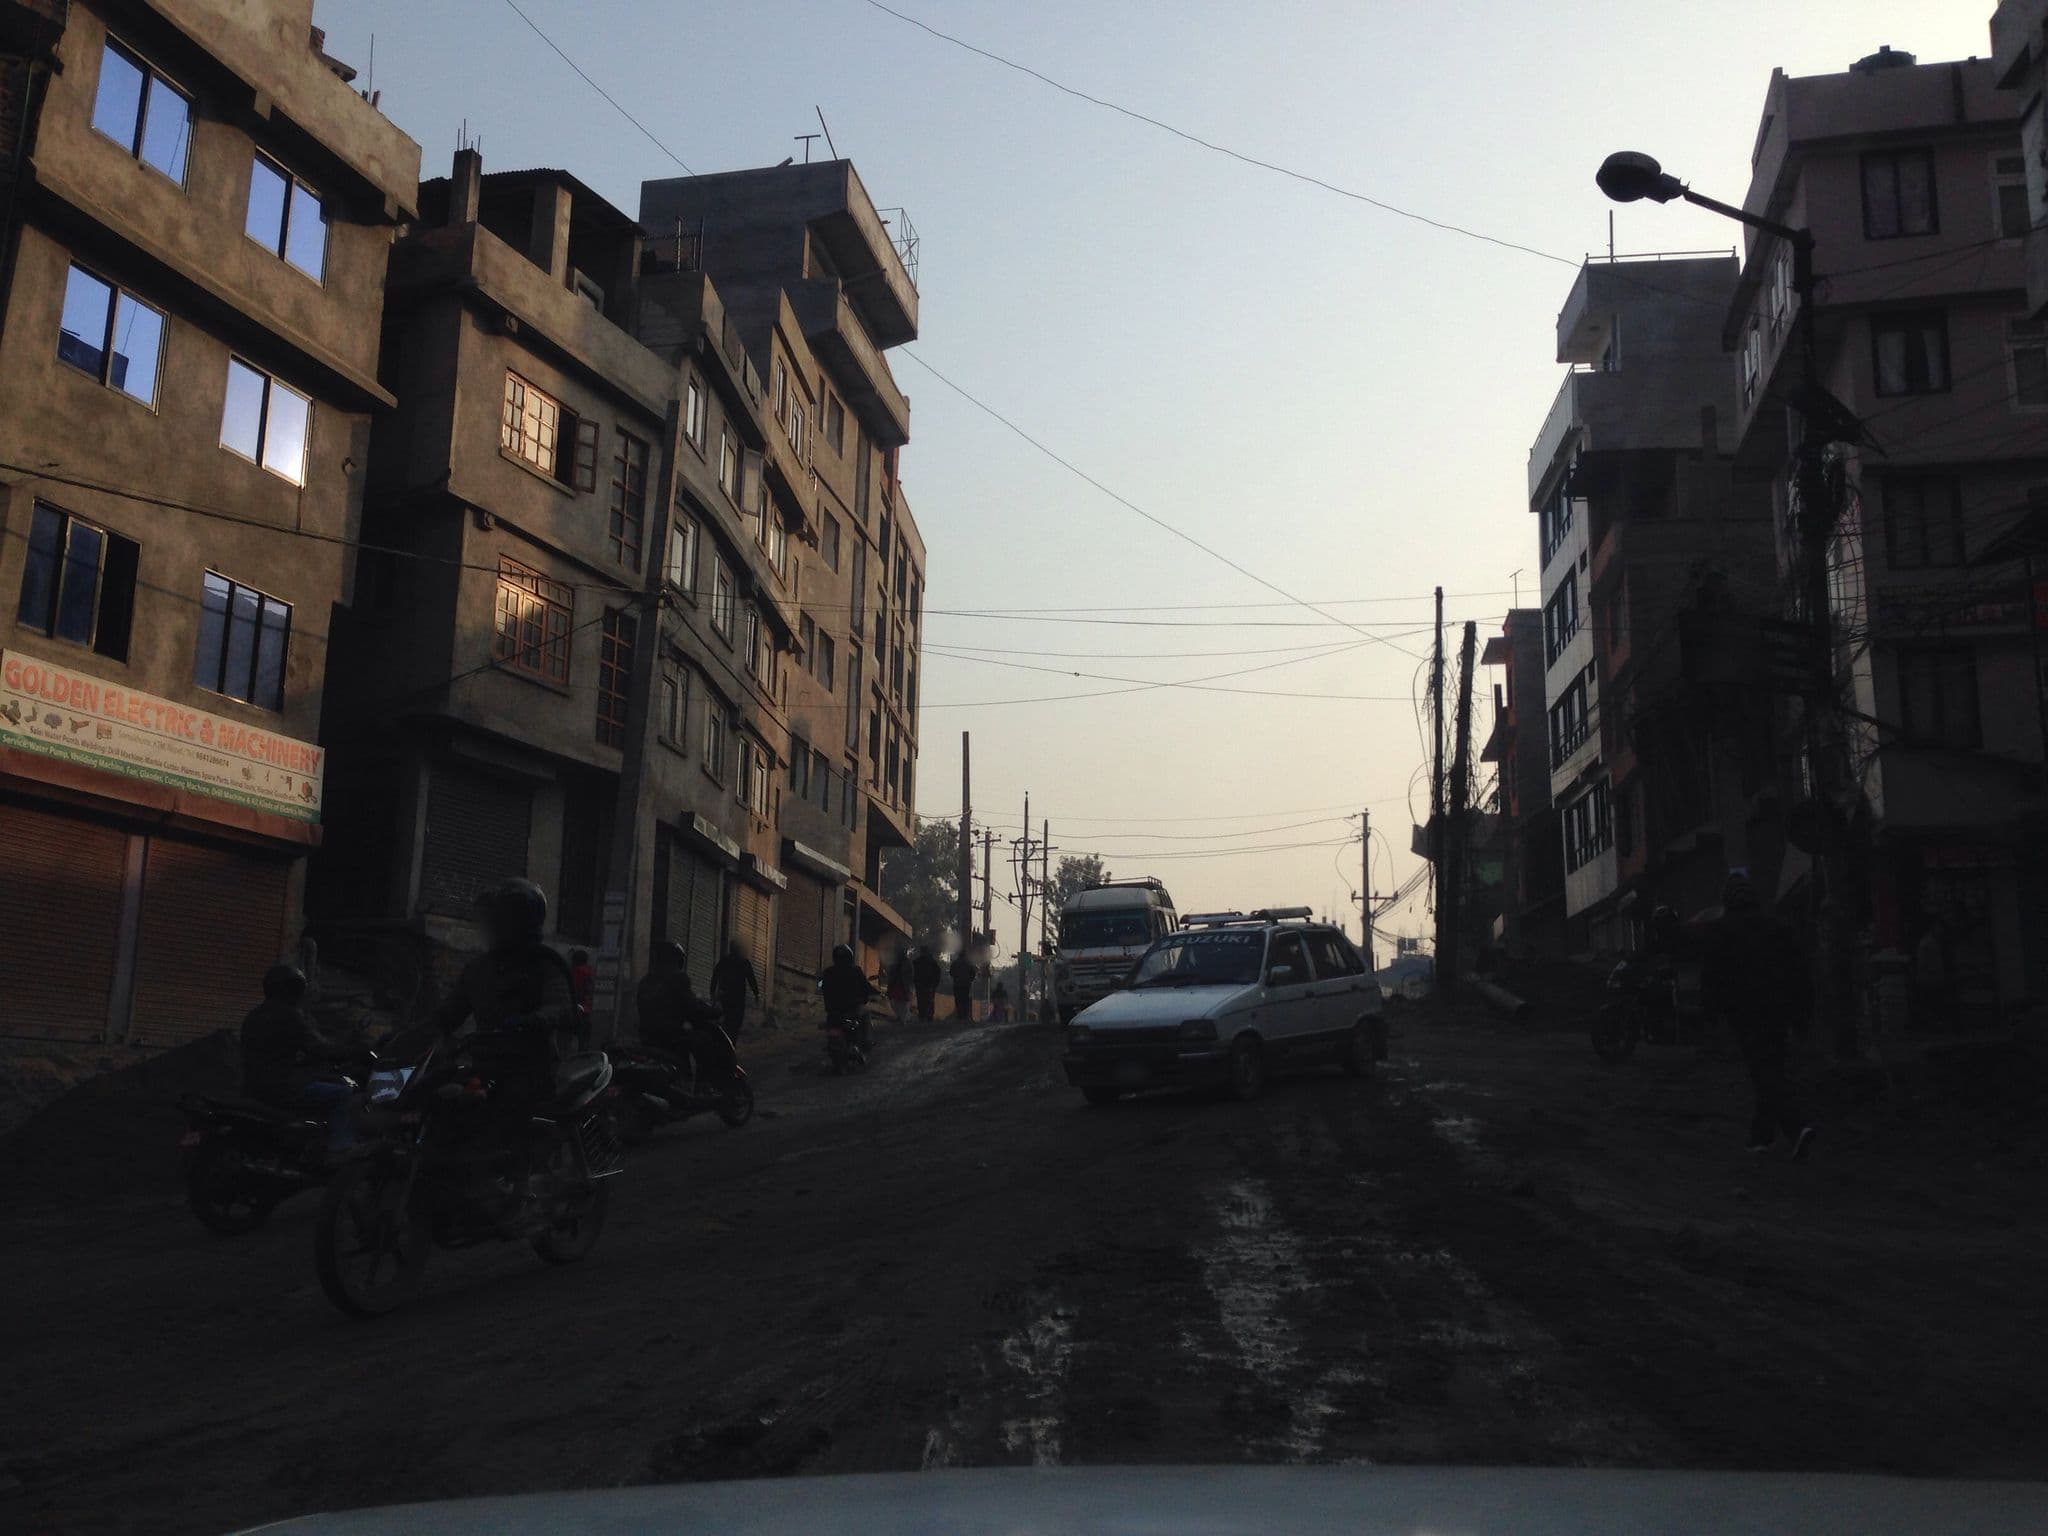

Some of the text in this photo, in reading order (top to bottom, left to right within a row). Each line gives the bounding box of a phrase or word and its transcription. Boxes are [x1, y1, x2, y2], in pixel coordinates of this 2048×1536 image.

[4, 658, 100, 712] GOLDEN
[199, 717, 214, 744] &
[218, 722, 321, 774] MACHINERY
[1175, 934, 1251, 945] SUZUKI
